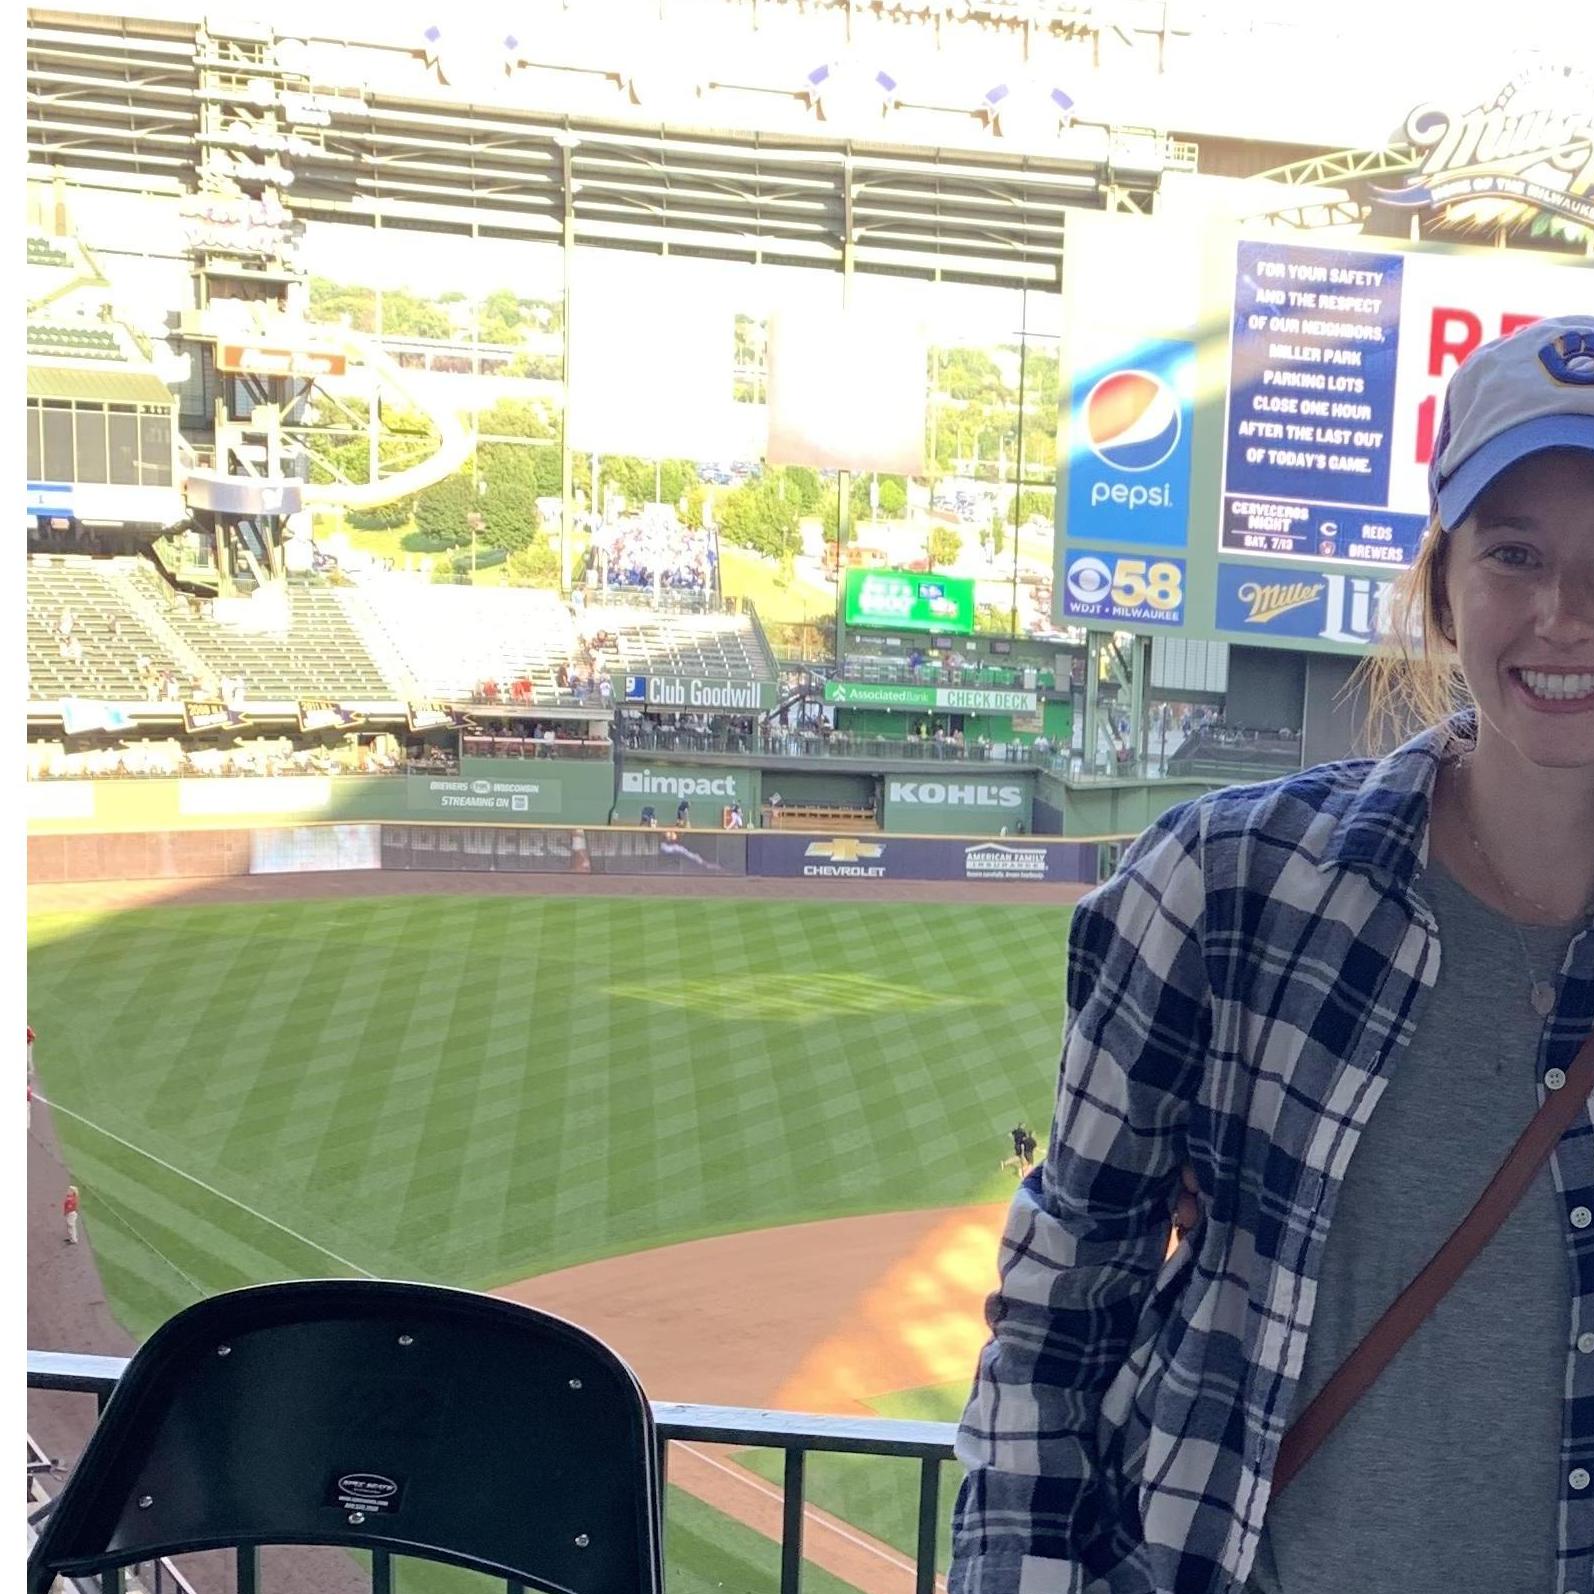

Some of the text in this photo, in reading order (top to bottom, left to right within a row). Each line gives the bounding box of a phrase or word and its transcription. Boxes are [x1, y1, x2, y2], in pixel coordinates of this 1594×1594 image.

[1256, 261, 1383, 287] FOR YOUR SAFETY
[1255, 288, 1382, 313] AND THE RESPECT
[1249, 315, 1385, 343] OF OUR NEIGHBORS,
[1269, 343, 1362, 366] MILLER PARK
[1263, 370, 1365, 393] PARKING LOTS
[1253, 396, 1372, 421] CLOSE ONE HOUR
[1238, 421, 1383, 448] AFTER THE LAST OUT
[1246, 448, 1372, 473] OF TODAY'S GAME.
[1091, 481, 1170, 511] pepsi
[1231, 501, 1309, 520] CERVECEROS
[1248, 516, 1292, 532] NIGHT
[1362, 524, 1393, 541] REDS
[1348, 543, 1404, 562] BREWERS
[1111, 559, 1182, 610] 58
[1069, 602, 1180, 621] WDJT MILWAUKEE
[1238, 582, 1326, 621] Miller
[650, 676, 761, 708] Club Goodwill
[947, 691, 991, 708] CHECK
[994, 693, 1028, 709] DECK
[430, 781, 468, 791] BREWERS
[493, 782, 539, 793] WISCONSIN
[644, 769, 736, 798] impact
[890, 781, 1023, 807] KOHL'S
[441, 796, 495, 807] STREAMING
[496, 797, 509, 807] ON
[967, 852, 1046, 861] AMERICAN FAMILY
[803, 865, 886, 877] CHEVROLET
